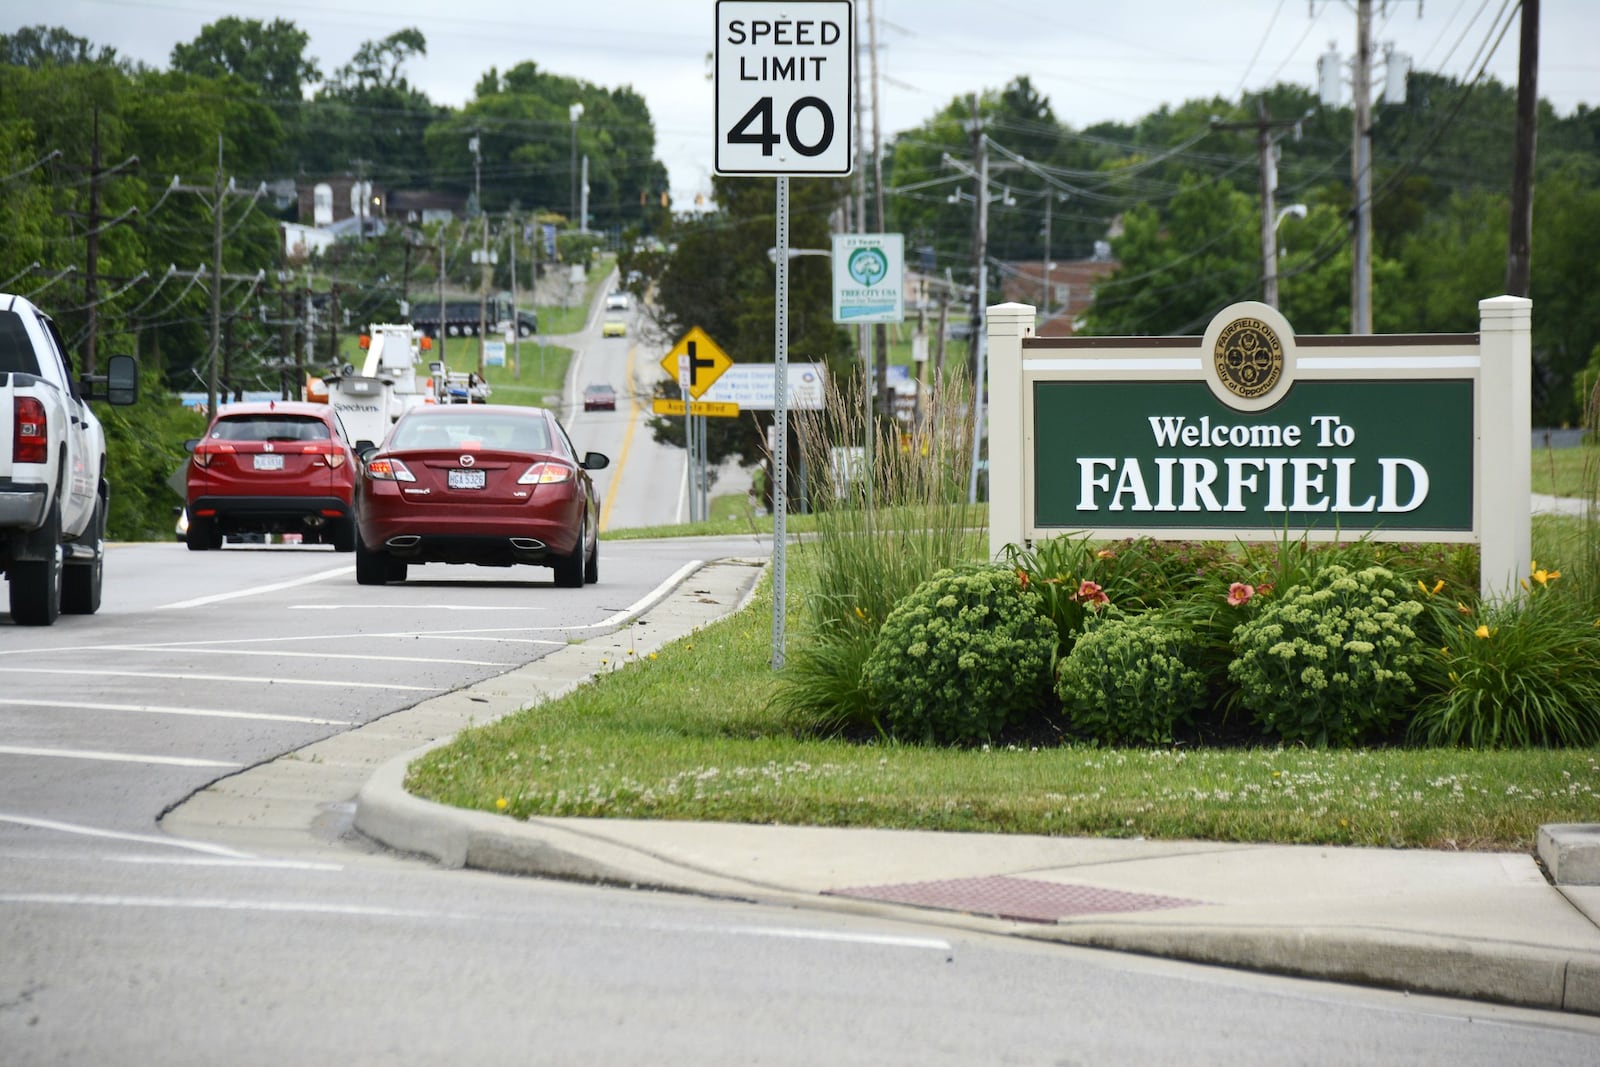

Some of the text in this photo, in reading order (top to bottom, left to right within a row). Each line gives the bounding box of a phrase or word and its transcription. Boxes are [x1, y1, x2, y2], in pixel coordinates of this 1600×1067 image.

[727, 20, 841, 45] SPEED
[740, 56, 827, 81] LIMIT
[727, 96, 835, 157] 40
[841, 288, 896, 297] TREE CITY USA
[1261, 326, 1279, 351] OHIO
[1218, 363, 1281, 396] City of Opportunity
[706, 403, 726, 413] Blvd
[1148, 415, 1355, 447] Welcome To
[465, 474, 484, 485] 5326
[1076, 457, 1429, 513] FAIRFIELD
